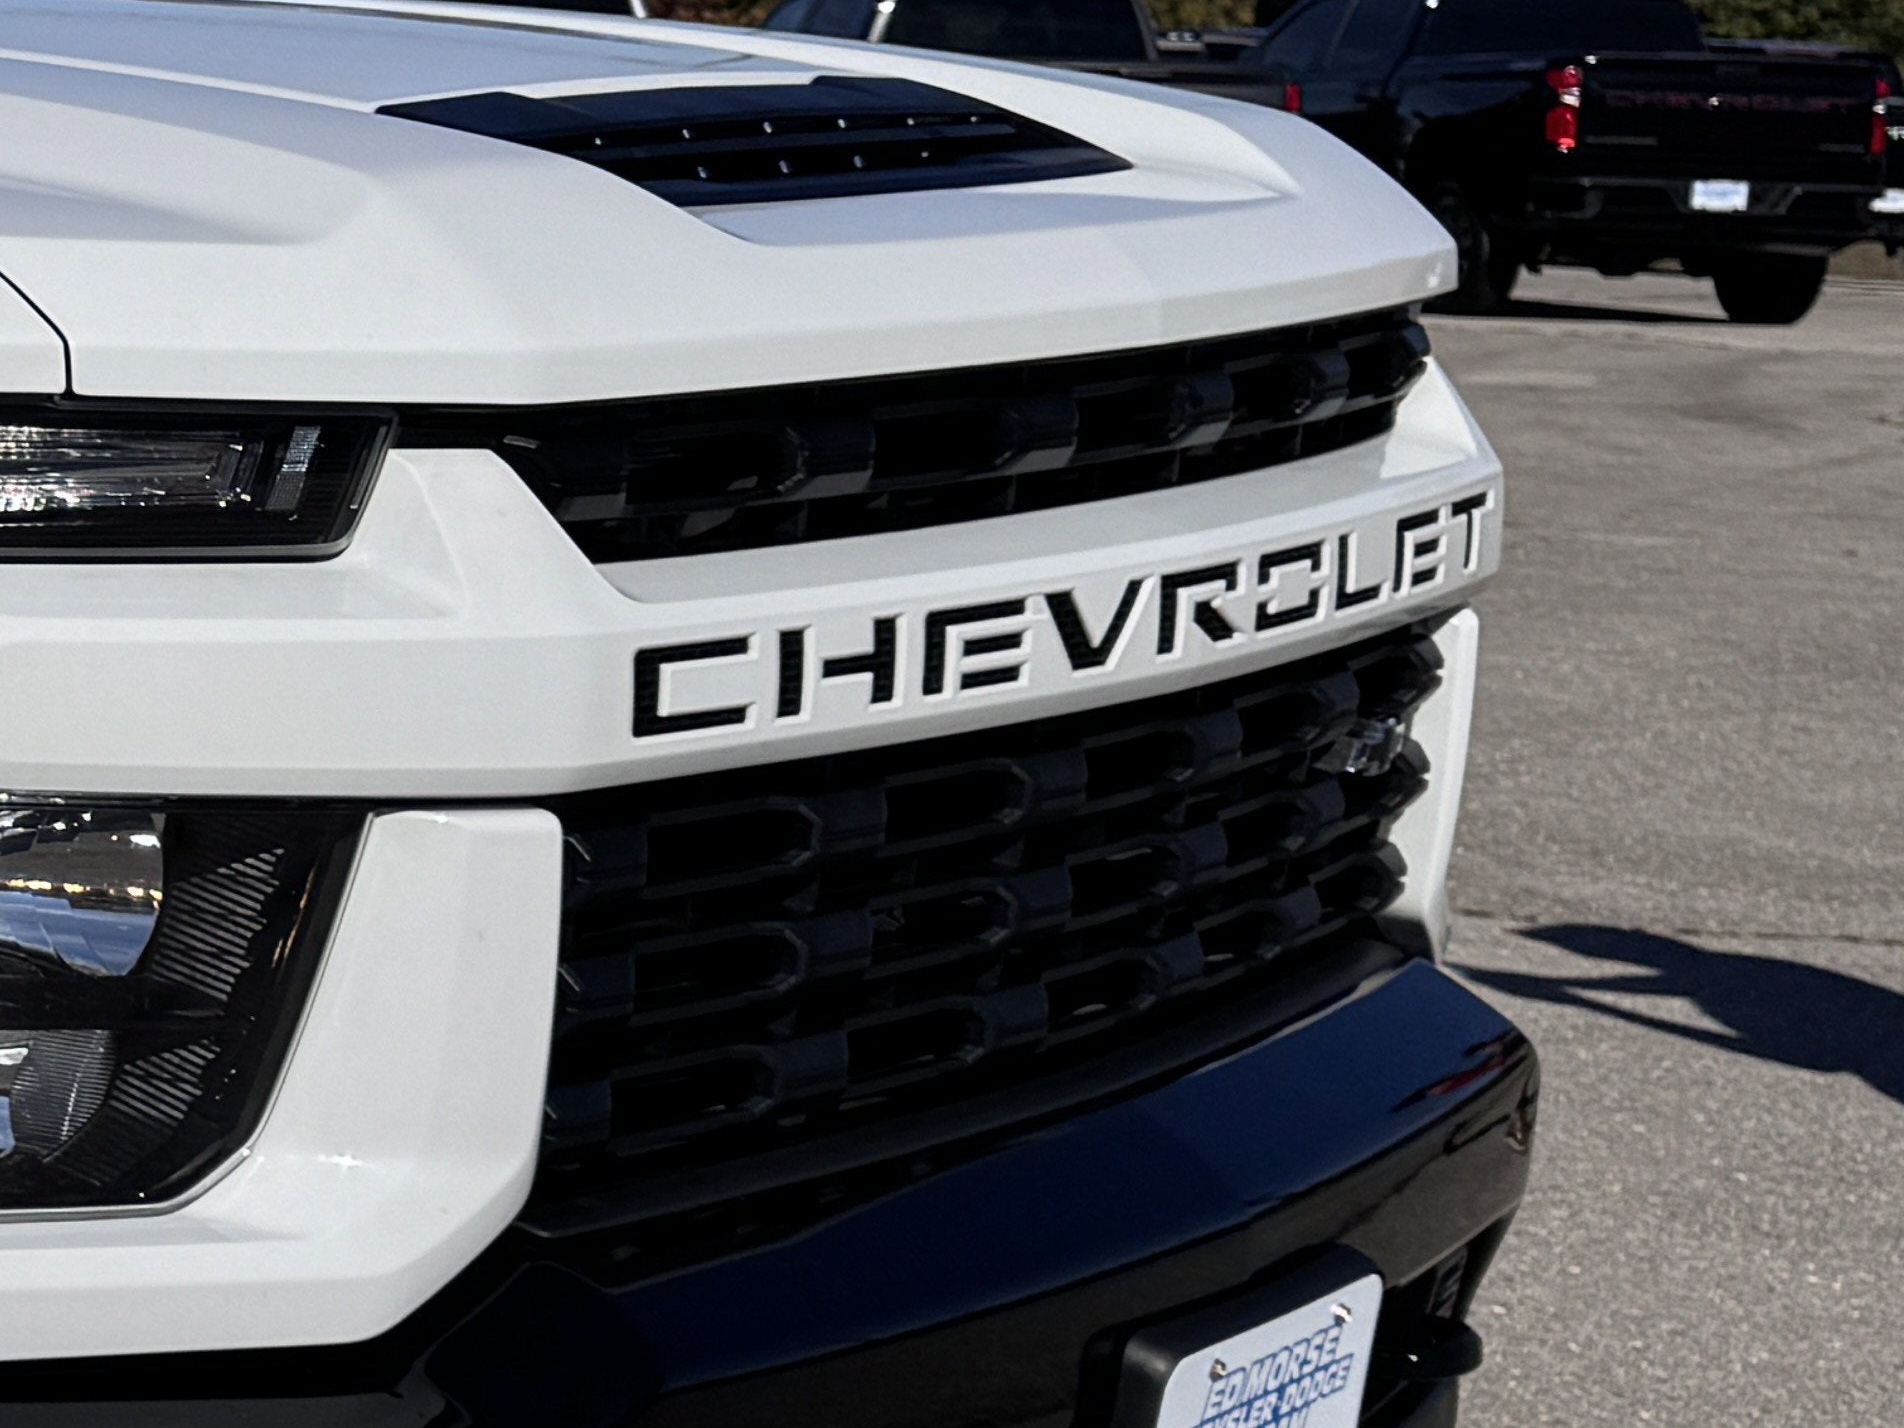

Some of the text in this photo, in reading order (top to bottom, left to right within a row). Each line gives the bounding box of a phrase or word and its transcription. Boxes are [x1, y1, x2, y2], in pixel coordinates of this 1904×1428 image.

[631, 487, 1496, 740] CHEVROLET
[1201, 1323, 1344, 1422] ED MORSE
